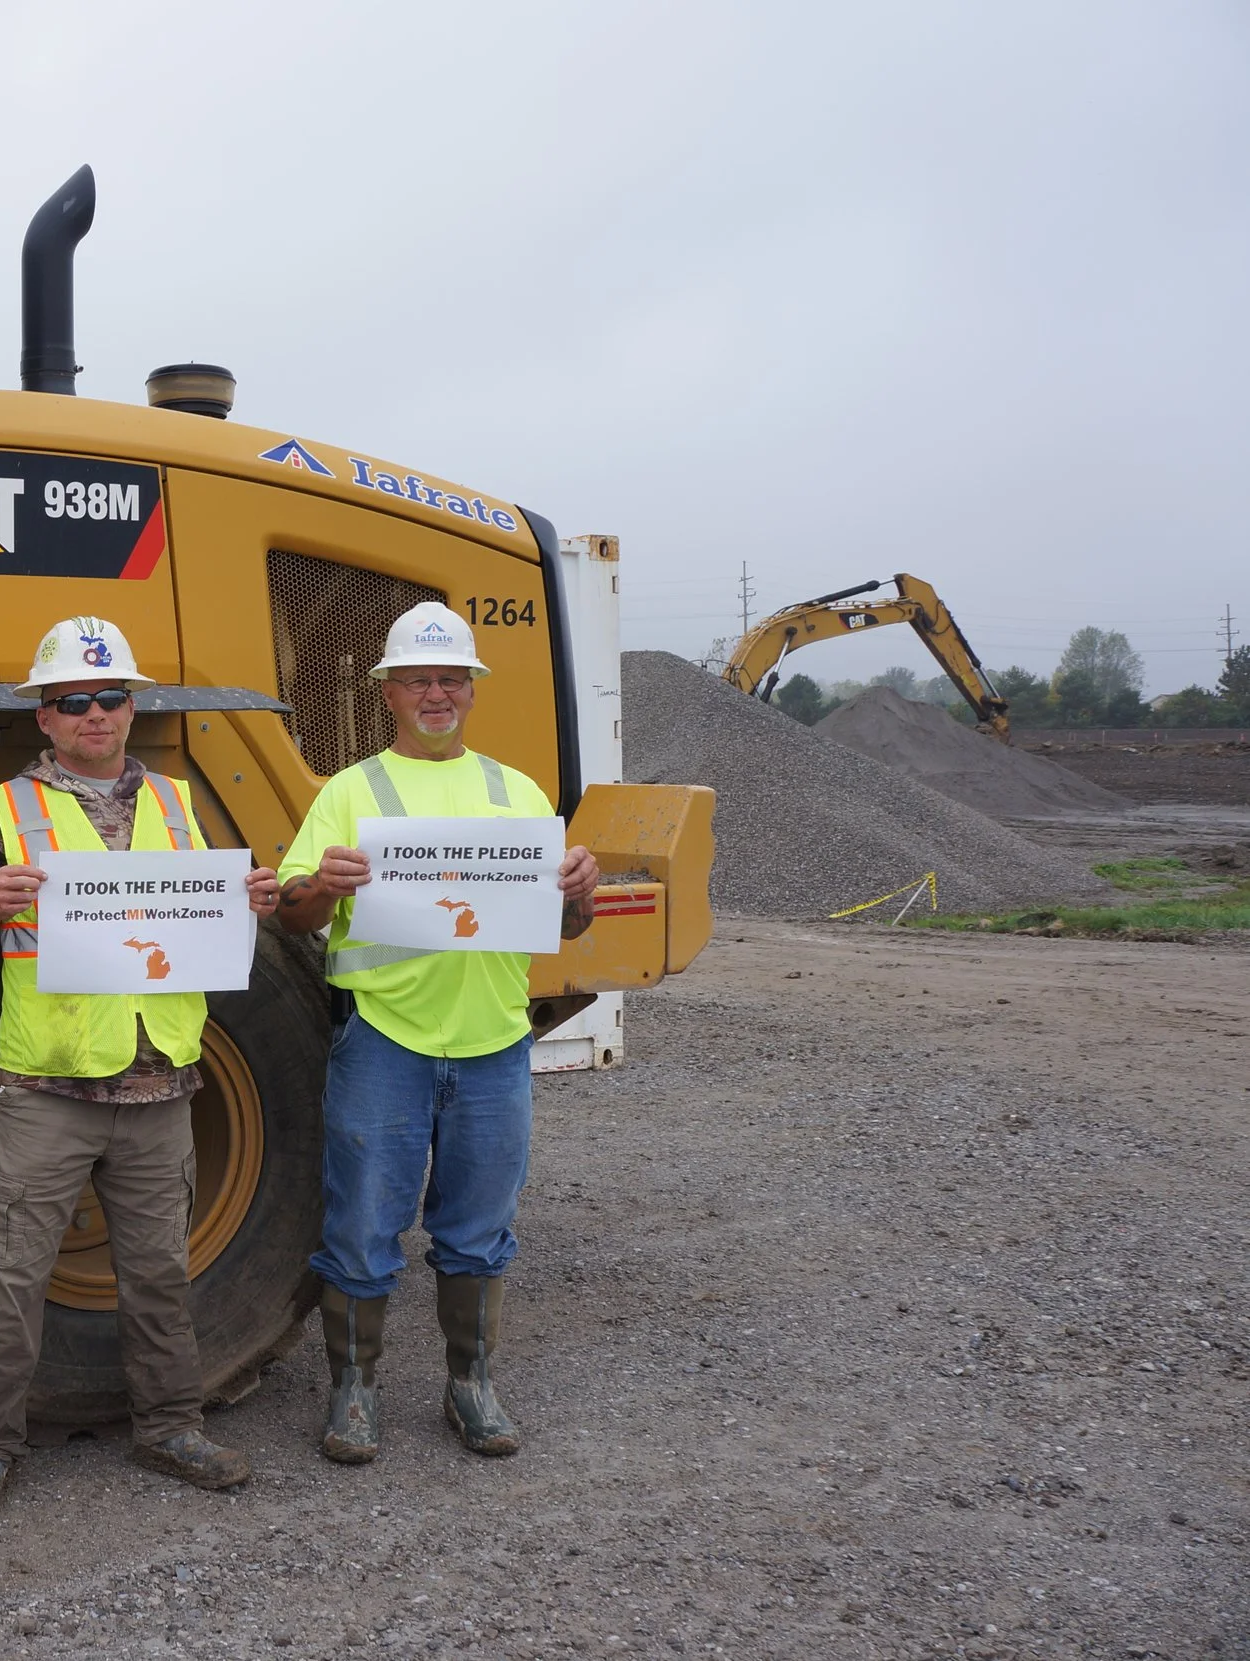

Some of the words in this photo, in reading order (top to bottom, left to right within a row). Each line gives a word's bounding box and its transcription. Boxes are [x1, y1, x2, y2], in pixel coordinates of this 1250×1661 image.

[44, 480, 140, 521] 938M
[348, 456, 517, 532] Iafrate
[466, 596, 536, 627] 1264
[848, 614, 866, 628] CAT
[383, 847, 389, 859] I
[394, 847, 438, 859] TOOK
[443, 847, 474, 859] THE
[478, 847, 543, 860] PLEDGE
[381, 870, 539, 883] #ProtectMIWorkZones
[65, 883, 70, 895] I
[75, 882, 120, 895] TOOK
[125, 881, 156, 894] THE
[161, 880, 226, 893] PLEDGE
[65, 908, 224, 922] #ProtectMIWorkZones
